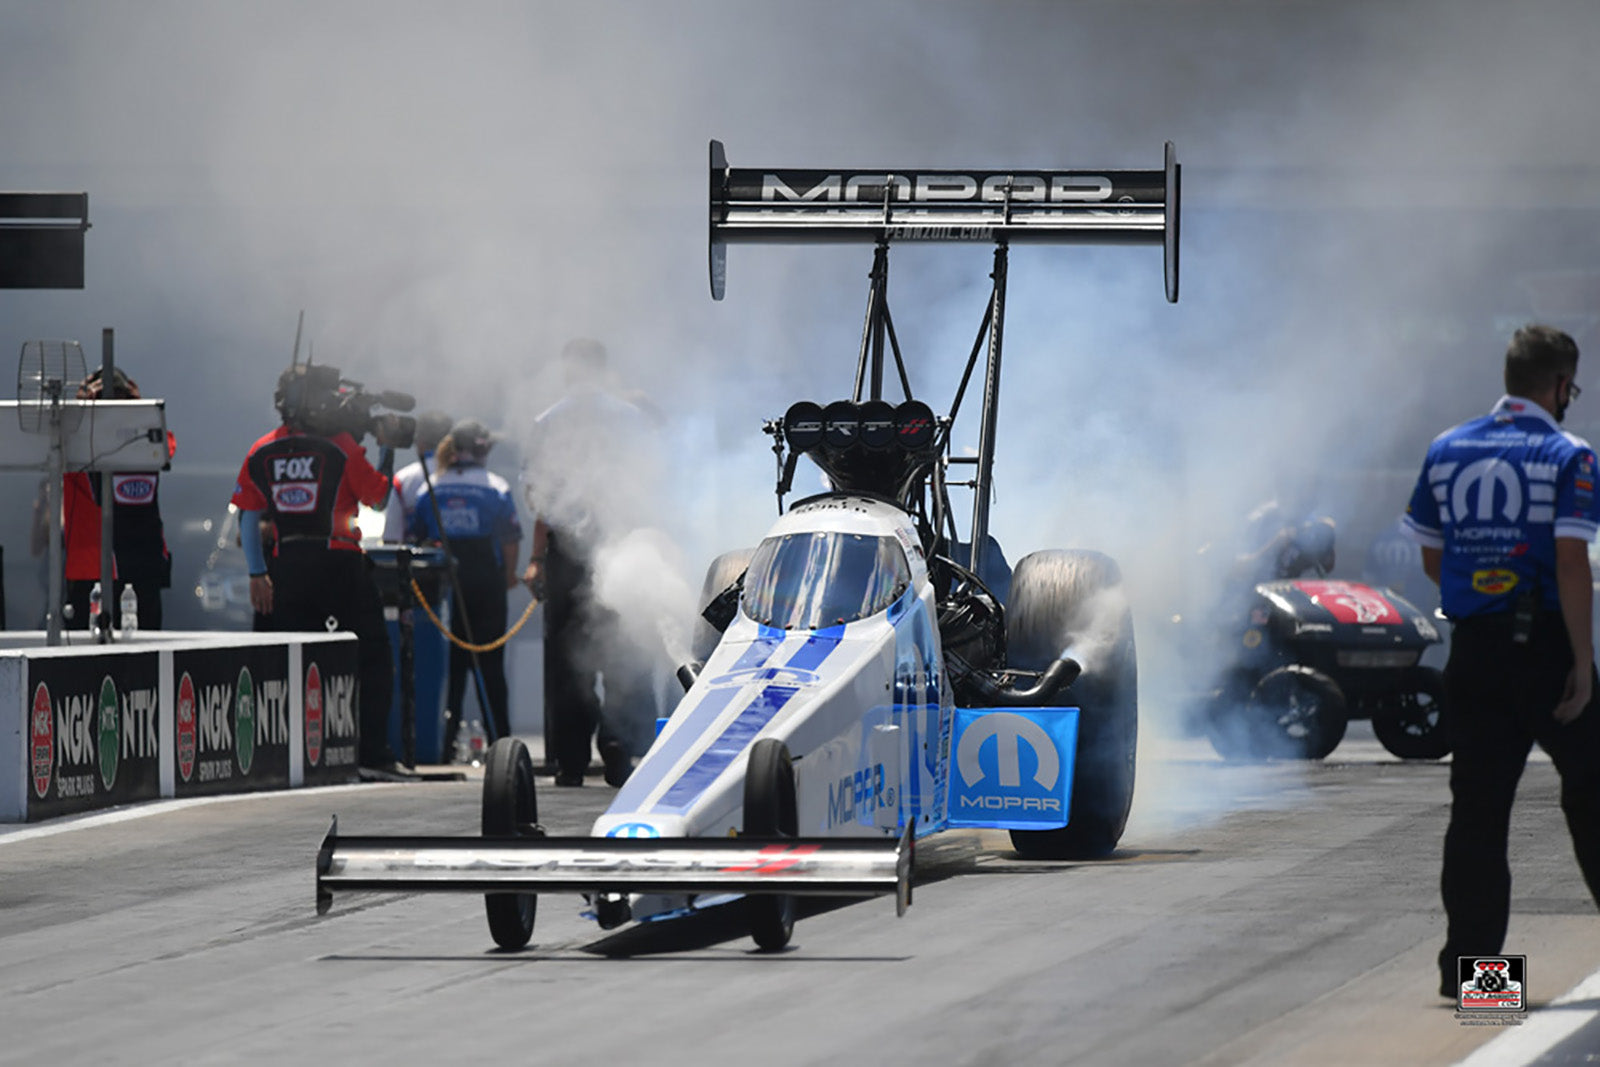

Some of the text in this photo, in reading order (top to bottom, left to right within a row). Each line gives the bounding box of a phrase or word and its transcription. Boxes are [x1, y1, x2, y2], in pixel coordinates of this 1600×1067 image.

[762, 174, 1114, 216] MOPAR
[884, 226, 995, 240] PENNZOIL.COM
[274, 456, 314, 481] FOX
[57, 693, 94, 767] NGK
[122, 687, 158, 760] NTK
[199, 683, 232, 752] NGK
[257, 679, 288, 746] NTK
[325, 674, 355, 739] NGK
[828, 763, 885, 829] MOPAR
[961, 795, 1061, 812] MOPAR
